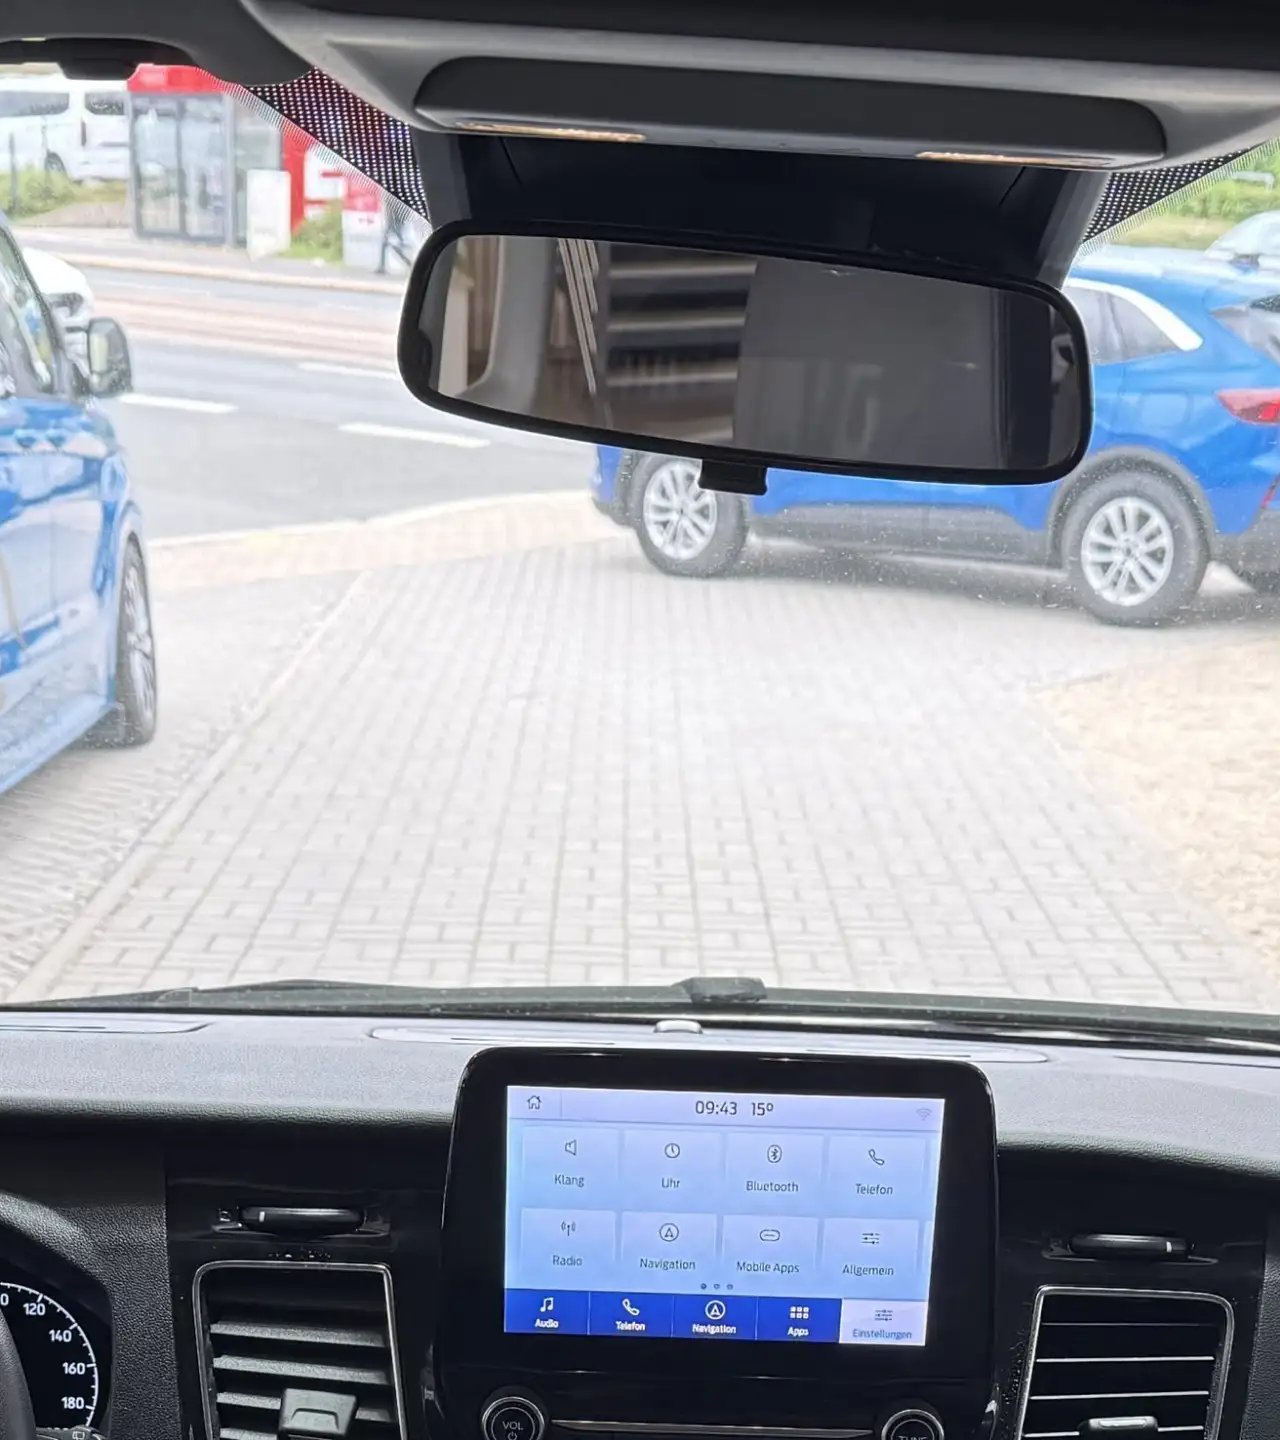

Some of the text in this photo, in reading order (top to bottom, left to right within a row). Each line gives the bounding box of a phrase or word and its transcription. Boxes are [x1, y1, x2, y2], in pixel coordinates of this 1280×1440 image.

[695, 1100, 738, 1116] 09:43
[554, 1174, 585, 1188] Klang
[661, 1178, 681, 1189] Uhr
[746, 1180, 799, 1193] Bluetooth
[856, 1183, 893, 1196] Telefon
[552, 1254, 583, 1267] Radio
[639, 1257, 696, 1271] Navigation
[736, 1260, 800, 1276] Mobile Apps
[842, 1263, 894, 1277] Allgemein
[23, 1302, 46, 1316] 120
[534, 1317, 559, 1329] Audio
[615, 1320, 646, 1332] Telefon
[691, 1322, 737, 1336] Navigation
[49, 1329, 72, 1343] 140
[787, 1325, 810, 1338] Apps
[851, 1328, 912, 1341] Einstellungen
[62, 1361, 86, 1375] 160
[61, 1396, 85, 1410] 180
[502, 1420, 524, 1431] VOL
